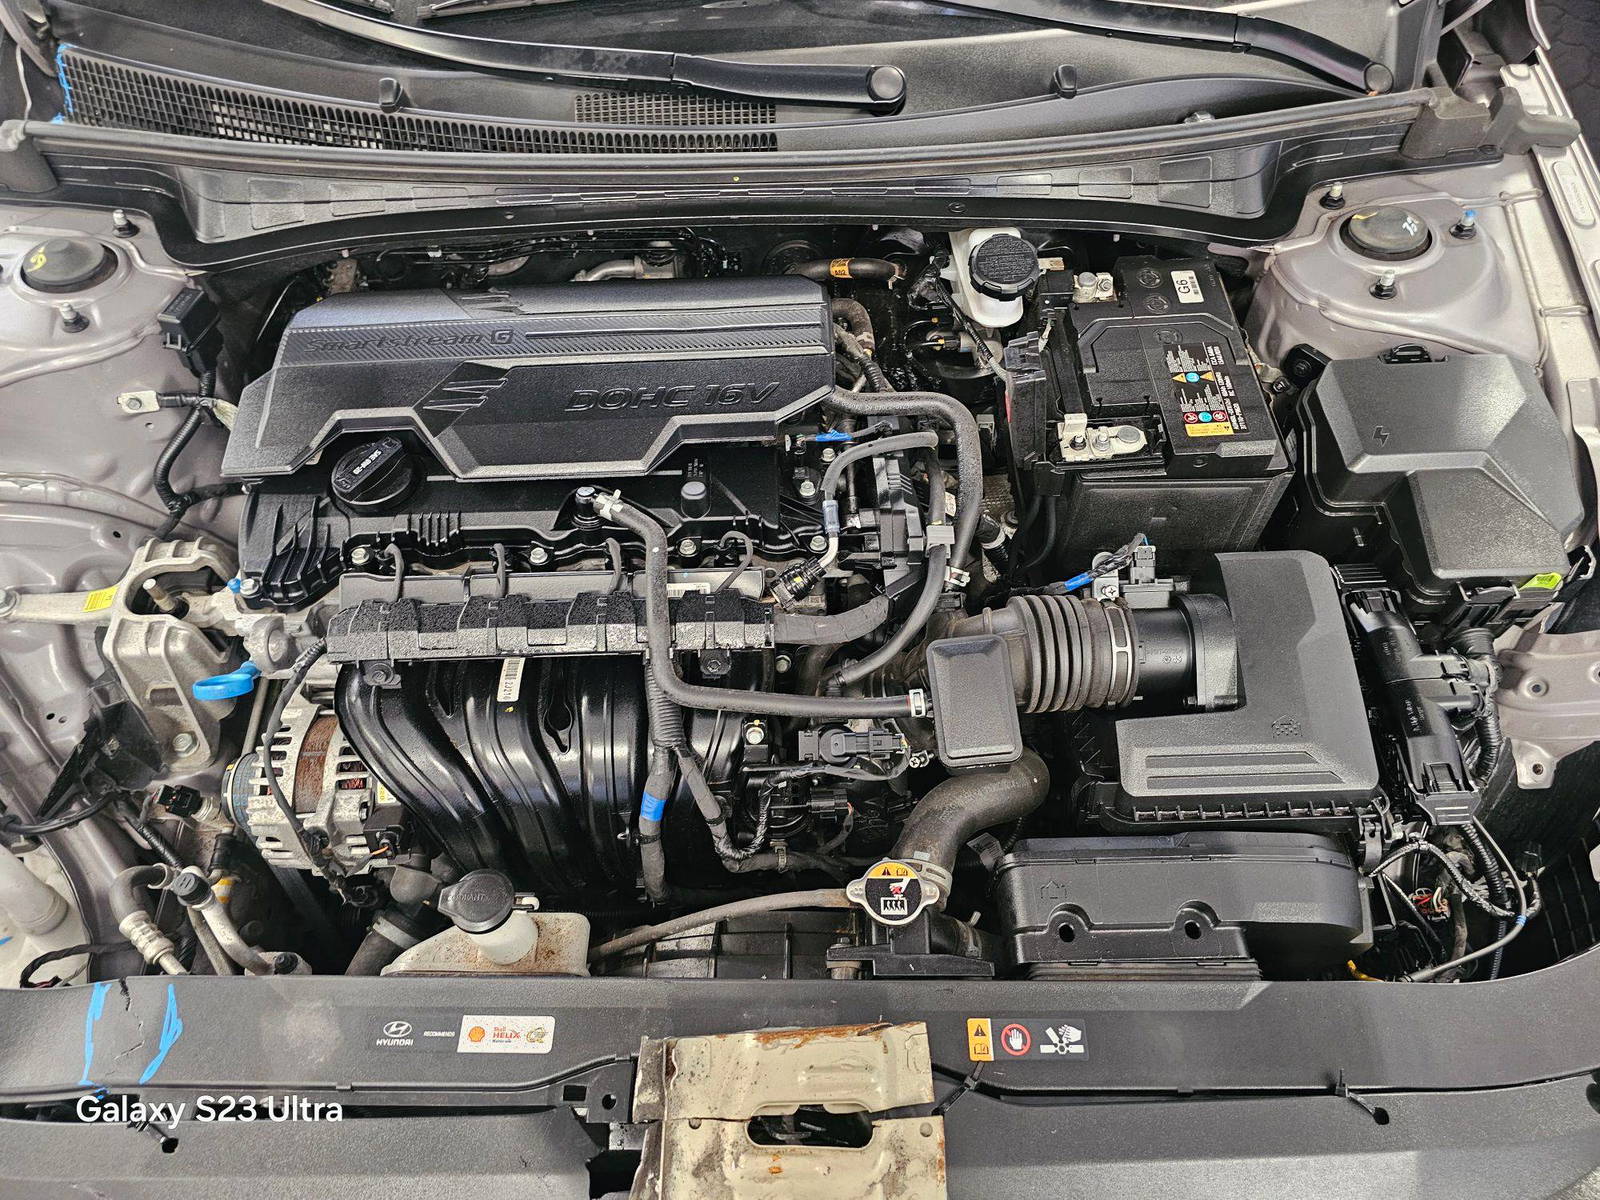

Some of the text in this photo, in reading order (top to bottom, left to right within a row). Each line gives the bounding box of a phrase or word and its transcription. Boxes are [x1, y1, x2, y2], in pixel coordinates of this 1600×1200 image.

[1176, 279, 1190, 294] G6
[303, 334, 485, 351] Smartstream
[565, 381, 780, 412] DOHC 16V
[352, 448, 382, 475] SAE 0W-20
[493, 1031, 521, 1039] HELIX
